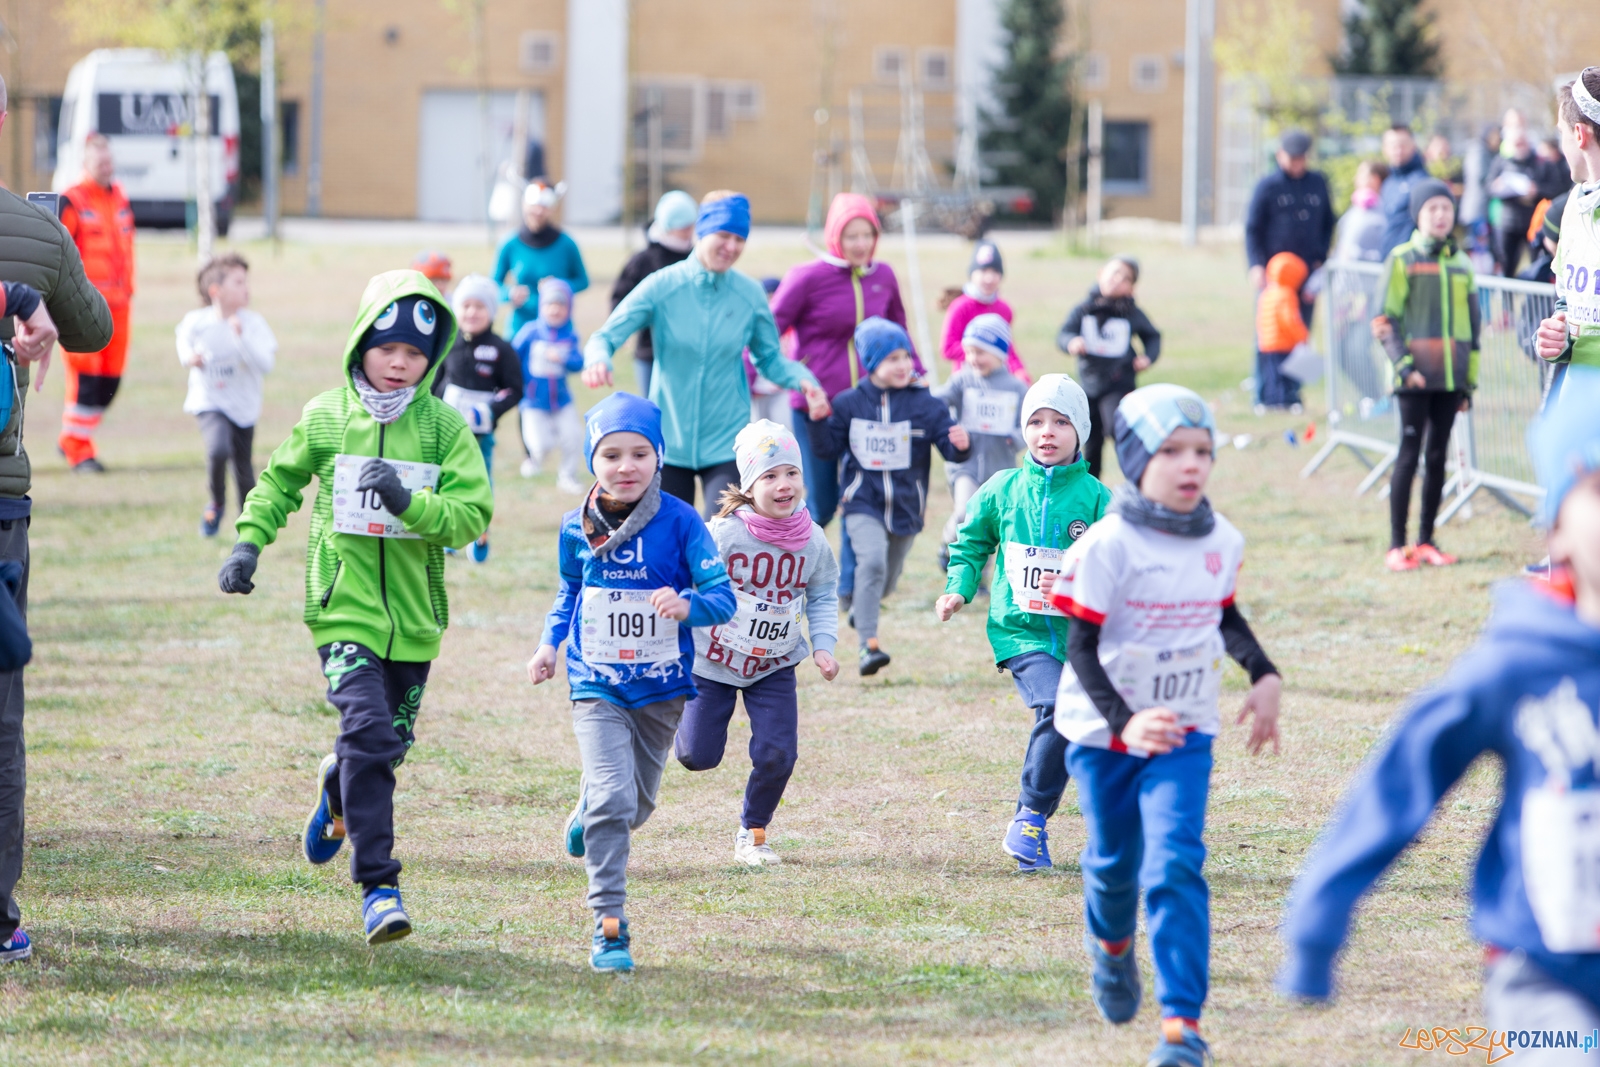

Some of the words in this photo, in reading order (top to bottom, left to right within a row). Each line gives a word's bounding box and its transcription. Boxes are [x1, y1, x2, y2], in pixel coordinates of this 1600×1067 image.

[602, 566, 648, 580] POZNAŃ
[727, 551, 808, 588] COOL
[607, 612, 656, 638] 1091
[748, 618, 791, 641] 1054
[1152, 667, 1204, 701] 1077
